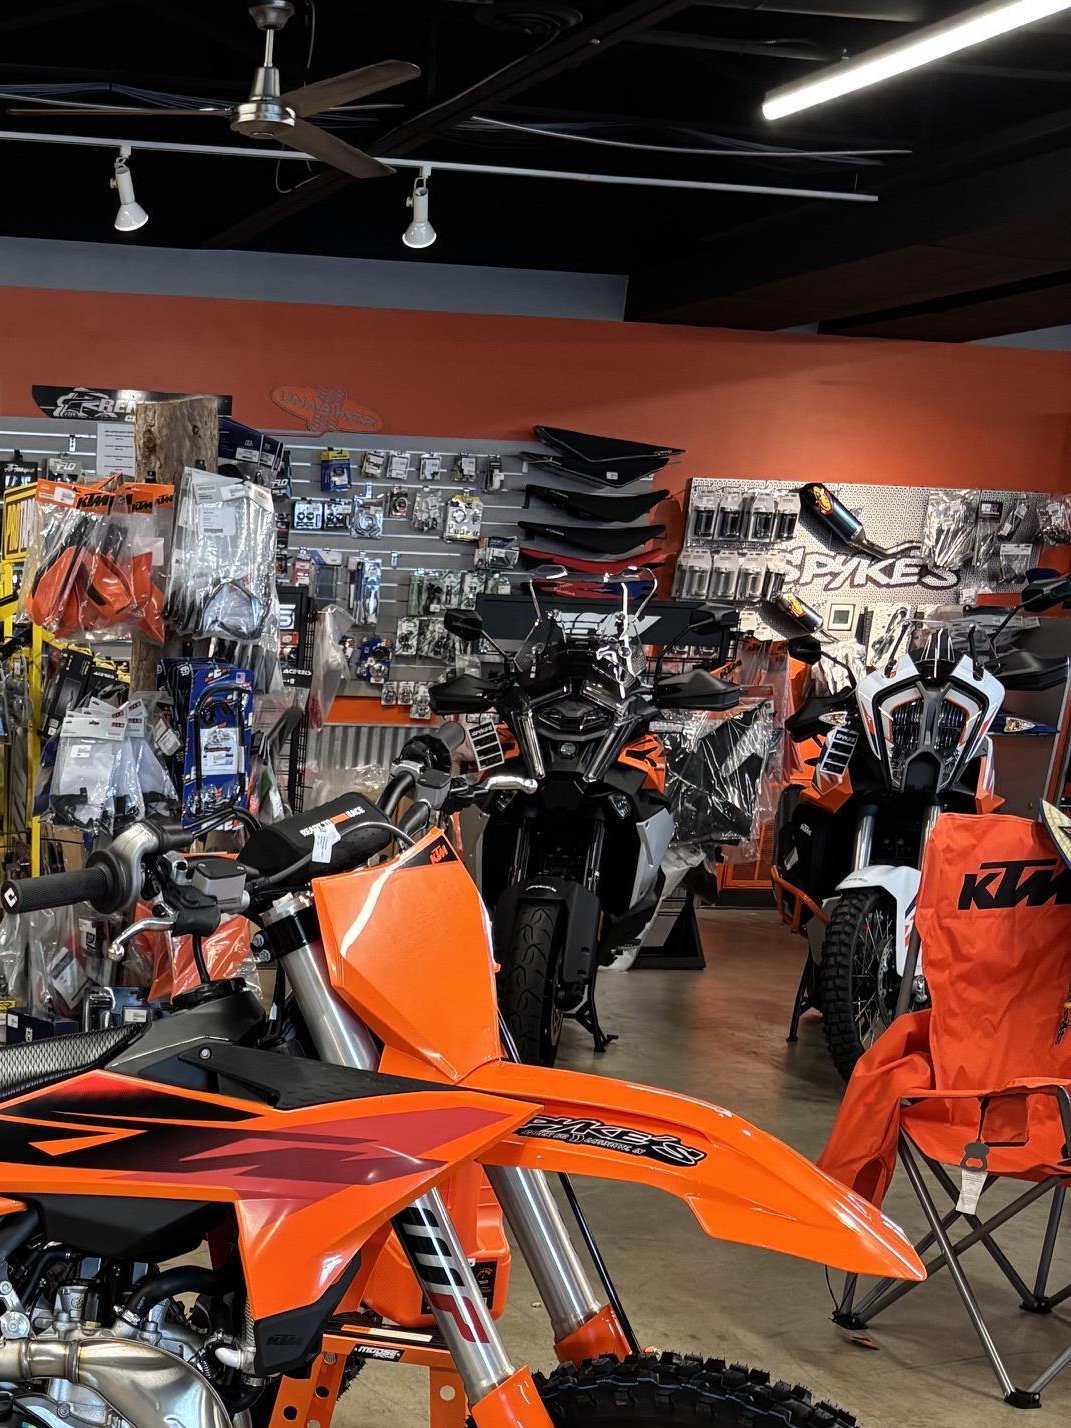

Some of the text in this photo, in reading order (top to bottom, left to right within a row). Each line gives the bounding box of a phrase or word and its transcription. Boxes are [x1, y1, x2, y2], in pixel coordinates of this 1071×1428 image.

[345, 806, 366, 818] RACE
[430, 844, 448, 865] KTM
[957, 859, 1071, 911] KTM
